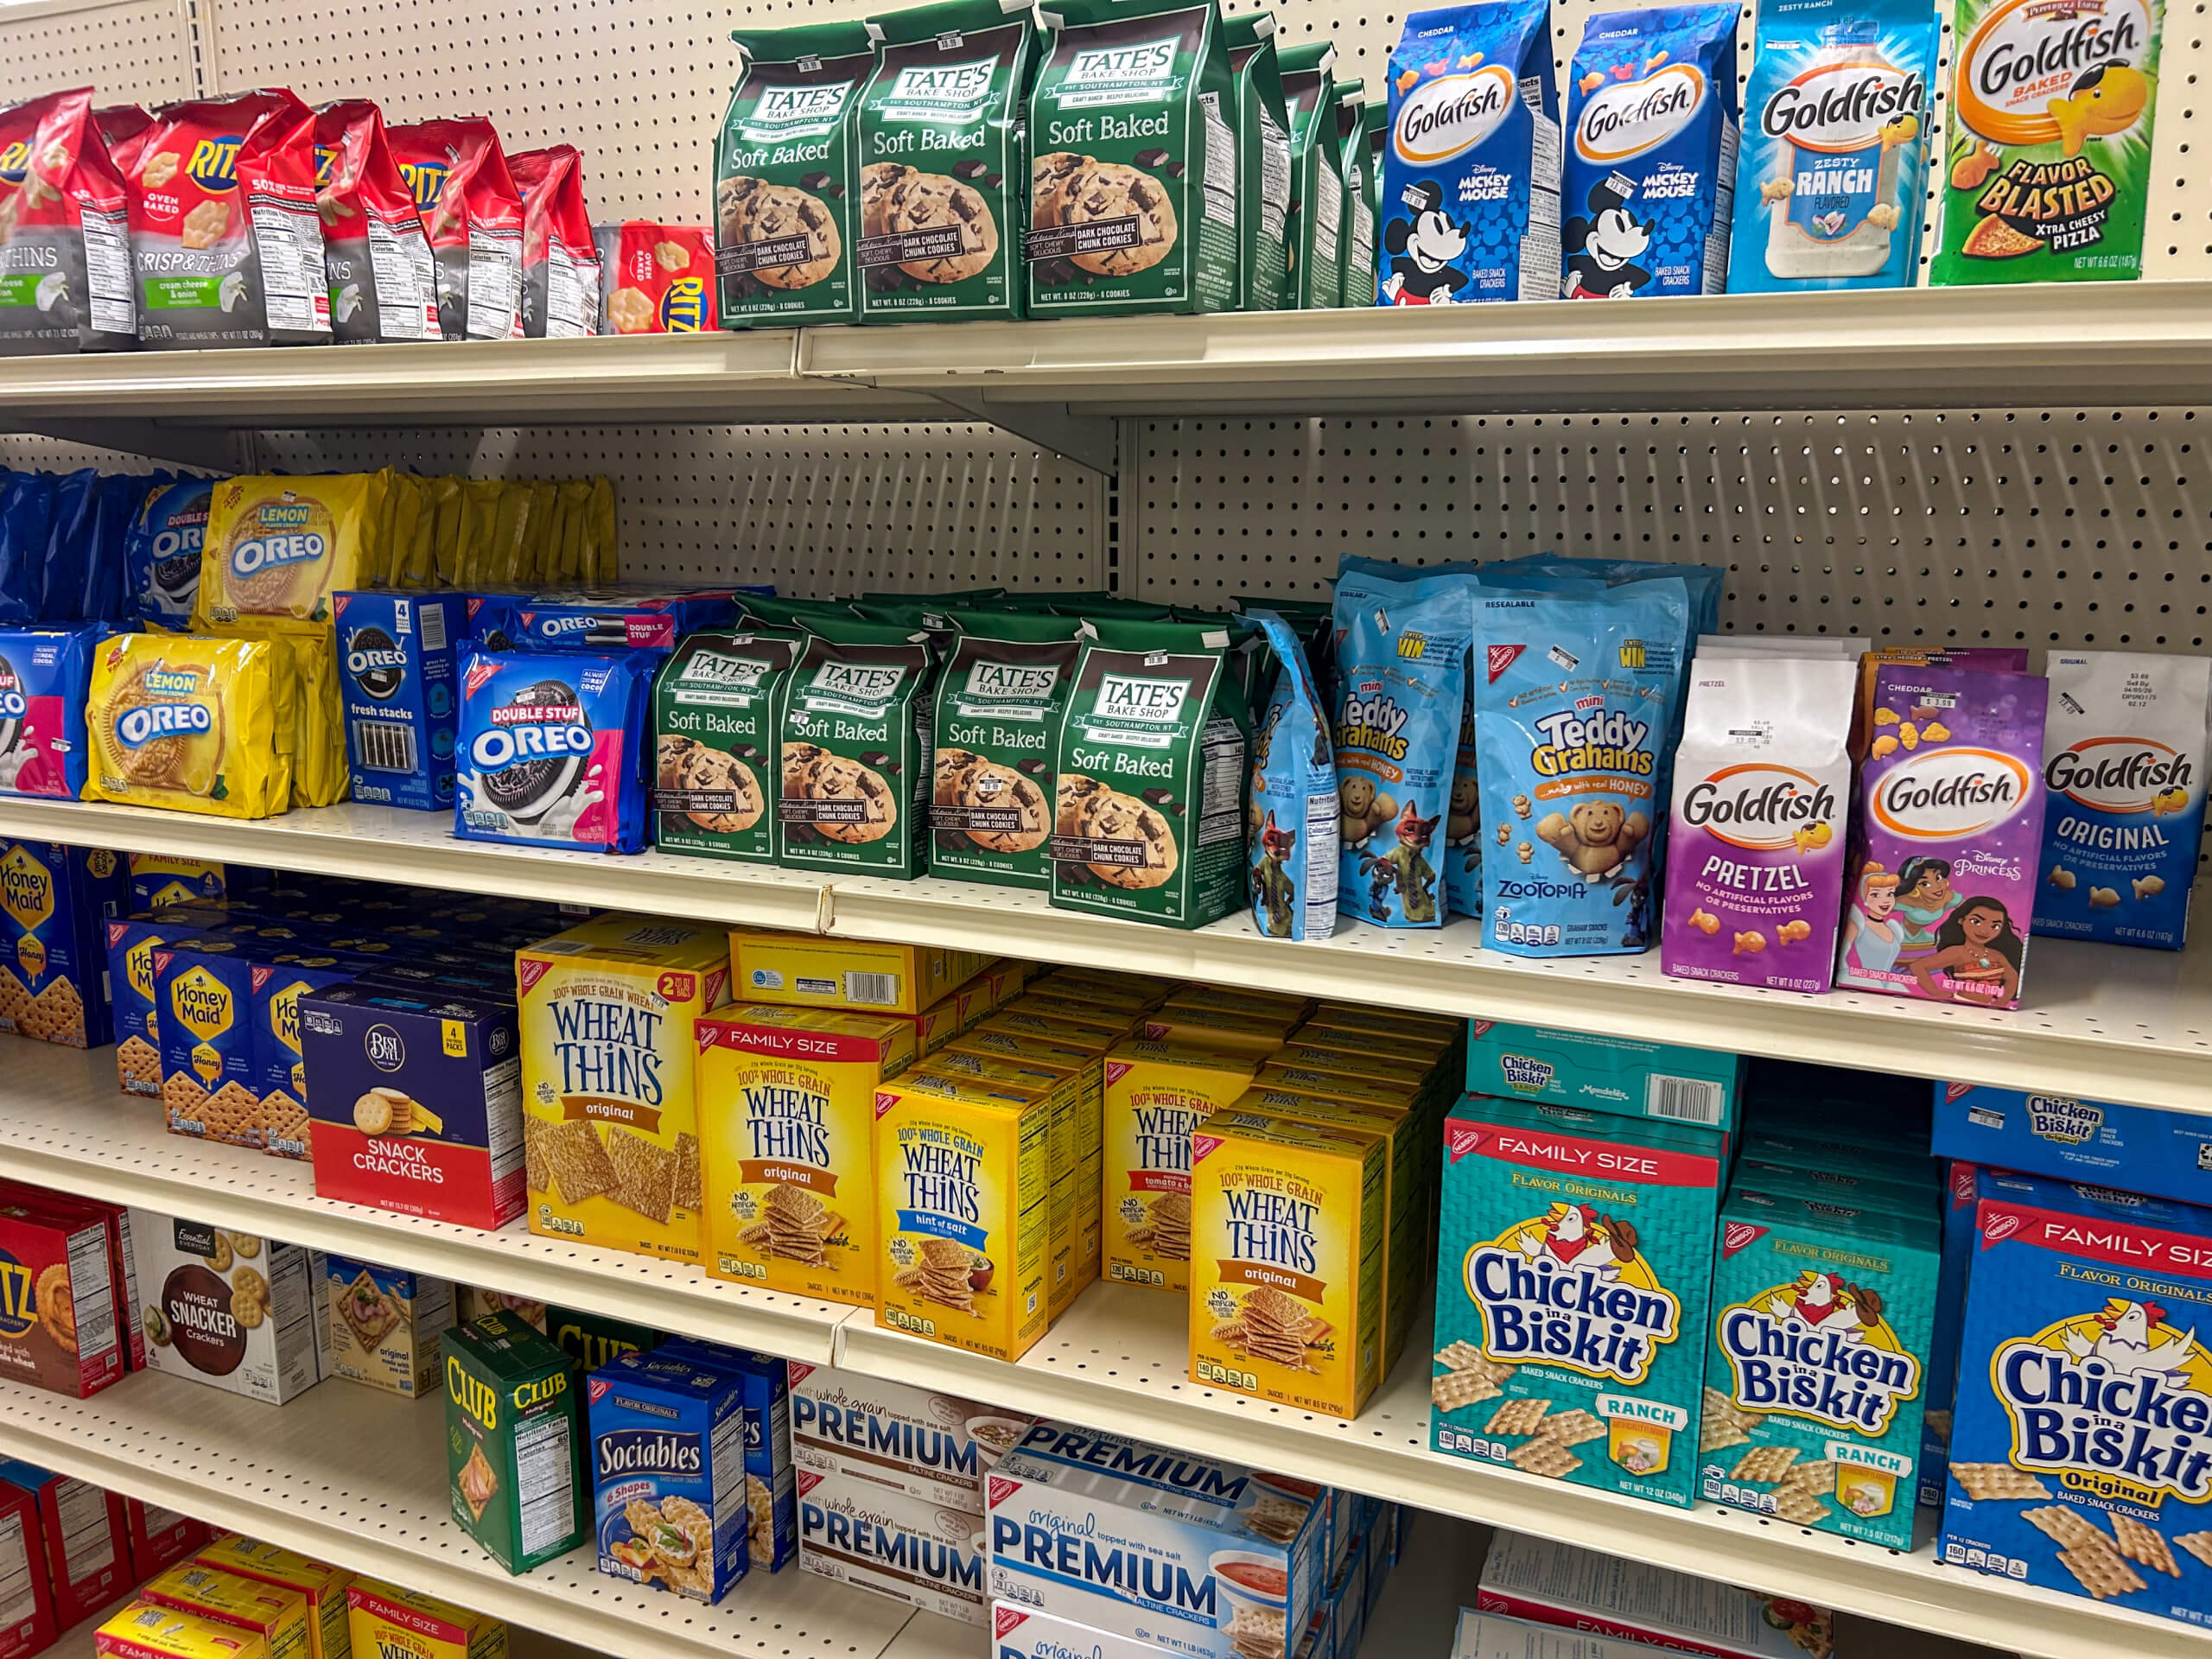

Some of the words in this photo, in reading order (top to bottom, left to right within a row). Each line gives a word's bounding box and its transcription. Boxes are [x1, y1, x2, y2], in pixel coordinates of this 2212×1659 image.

[1418, 26, 1453, 37] CHEDDAR
[1079, 45, 1170, 72] TATE'S
[1980, 14, 2135, 94] Goldfish
[905, 64, 992, 89] TATE'S
[2013, 72, 2073, 98] BAKED
[767, 86, 845, 109] TATE'S
[904, 99, 971, 109] SOUTHAMPTON
[906, 88, 939, 97] BAKE
[944, 87, 978, 97] SHOP
[1764, 73, 1922, 136] Goldfish
[1049, 119, 1093, 144] Soft
[1100, 111, 1169, 140] Baked
[874, 132, 914, 154] Soft
[919, 127, 986, 150] Baked
[187, 140, 240, 176] RIT
[1815, 157, 1859, 168] ZESTY
[1459, 175, 1512, 189] MICKEY
[1796, 169, 1872, 196] RANCH
[2008, 159, 2093, 184] FLAVOR
[252, 179, 276, 193] 50%
[1459, 187, 1509, 200] MOUSE
[1981, 175, 2115, 219] BLASTED
[143, 201, 180, 214] BAKED
[148, 194, 179, 204] OVEN
[1815, 196, 1849, 209] FLAVORED
[2036, 222, 2065, 235] XTRA
[2068, 211, 2106, 230] CHEESY
[904, 237, 919, 248] DARK
[922, 232, 957, 245] CHOCOLATE
[905, 247, 925, 257] CHUNK
[927, 243, 955, 254] COOKIES
[2053, 228, 2101, 250] PIZZA
[2074, 257, 2086, 268] NET
[2088, 256, 2098, 268] WT
[2108, 256, 2118, 267] OZ
[160, 281, 181, 289] cream
[181, 280, 208, 289] cheese
[178, 289, 197, 298] onion
[669, 276, 703, 332] RITZ
[261, 507, 307, 522] LEMON
[233, 535, 323, 575] OREO
[543, 617, 598, 638] OREO
[348, 650, 406, 671] OREO
[146, 674, 195, 690] LEMON
[824, 665, 899, 689] TATE'S
[1888, 683, 1932, 693] CHEDDAR
[1106, 681, 1182, 708] TATE'S
[1576, 696, 1604, 709] mini
[352, 704, 377, 716] fresh
[378, 707, 413, 719] stacks
[493, 708, 543, 721] DOUBLE
[545, 706, 579, 719] STUF
[669, 712, 700, 730] Soft
[706, 715, 756, 734] Baked
[1108, 704, 1135, 715] BAKE
[1140, 708, 1168, 718] SHOP
[119, 705, 210, 746] OREO
[1537, 713, 1647, 753] Teddy
[473, 728, 591, 769] OREO
[1071, 748, 1109, 770] Soft
[1114, 753, 1173, 778] Baked
[1532, 747, 1652, 775] Grahams
[2047, 753, 2188, 790] Goldfish
[1573, 783, 1590, 792] with
[1592, 782, 1606, 791] real
[1610, 779, 1648, 795] HONEY
[1889, 772, 2010, 812] Goldfish
[1684, 783, 1832, 824] Goldfish
[2057, 817, 2169, 850] ORIGINAL
[1973, 850, 2008, 864] Disney
[1701, 856, 1809, 891] PRETZEL
[1954, 861, 2021, 880] PRINCESS
[1497, 881, 1586, 899] ZOOTOPIA
[1696, 880, 1711, 892] NO
[1713, 888, 1766, 903] ARTIFICIAL
[1768, 891, 1813, 903] FLAVORS
[1706, 896, 1717, 905] OR
[1719, 902, 1801, 914] PRESERVATIVES
[175, 983, 227, 1011] Honey
[183, 1004, 220, 1024] Maid
[548, 1000, 663, 1052] WHEAT
[731, 1031, 792, 1049] FAMILY
[798, 1039, 837, 1054] SIZE
[1502, 1056, 1552, 1075] Chicken
[738, 1071, 759, 1085] 100%
[761, 1070, 795, 1085] WHOLE
[798, 1074, 830, 1095] GRAIN
[1506, 1070, 1546, 1086] Biskit
[587, 1103, 634, 1121] original
[742, 1087, 829, 1127] WHEAT
[2031, 1097, 2101, 1122] Chicken
[2035, 1116, 2090, 1138] Biskit
[368, 1140, 426, 1164] SNACK
[1499, 1139, 1592, 1164] FAMILY
[1597, 1154, 1658, 1175] SIZE
[353, 1154, 443, 1184] CRACKERS
[765, 1166, 810, 1184] original
[900, 1144, 980, 1186] WHEAT
[1513, 1174, 1560, 1191] FLAVOR
[1565, 1183, 1637, 1204] ORIGINALS
[917, 1216, 936, 1225] hint
[947, 1223, 967, 1236] salt
[177, 1230, 212, 1247] Essential
[183, 1291, 219, 1305] WHEAT
[1475, 1253, 1669, 1330] Chicken
[171, 1301, 236, 1338] SNACKER
[187, 1330, 225, 1347] Crackers
[1489, 1305, 1643, 1373] Biskit
[380, 1347, 409, 1360] original
[1728, 1315, 1908, 1389] Chicken
[1522, 1366, 1543, 1378] BAKED
[1545, 1370, 1567, 1382] SNACK
[1568, 1375, 1604, 1389] CRACKERS
[447, 1356, 496, 1429] CLUB
[1739, 1359, 1885, 1426] Biskit
[817, 1388, 847, 1407] whole
[851, 1400, 887, 1423] grain
[1608, 1399, 1675, 1424] RANCH
[793, 1395, 977, 1475] PREMIUM
[601, 1435, 700, 1472] Sociables
[607, 1491, 615, 1503] 6
[616, 1481, 651, 1498] Shapes
[1619, 1481, 1631, 1490] NET
[1634, 1484, 1644, 1493] WT
[1655, 1489, 1664, 1497] OZ
[2067, 1472, 2158, 1503] Original
[1029, 1509, 1095, 1541] original
[993, 1515, 1217, 1616] PREMIUM
[369, 1599, 410, 1624] FAMILY
[412, 1615, 439, 1635] SIZE
